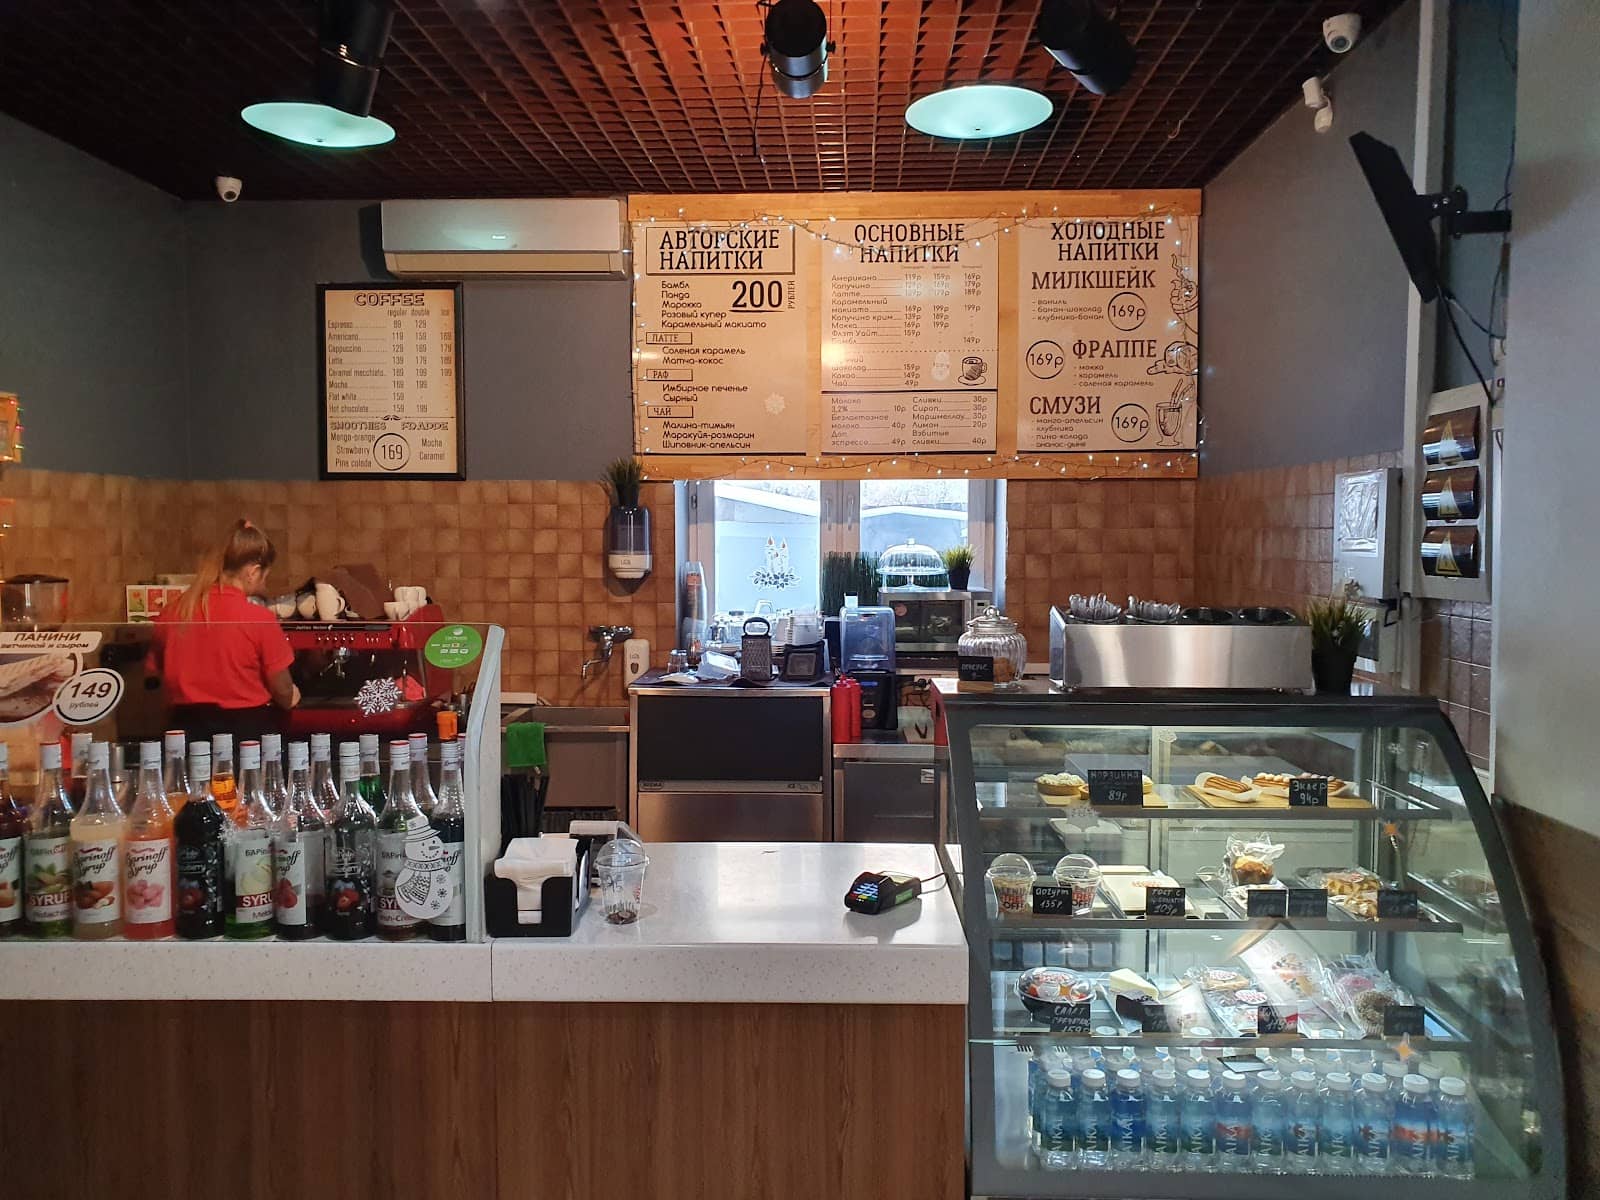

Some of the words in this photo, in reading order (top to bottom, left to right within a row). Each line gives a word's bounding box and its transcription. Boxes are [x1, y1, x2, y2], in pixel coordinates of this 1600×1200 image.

[854, 223, 964, 242] ОСНОВНЫЕ
[1051, 221, 1165, 241] ХОЛОДНЫЕ
[659, 230, 779, 249] АВТОРСКИЕ
[860, 244, 959, 263] НАПИТКИ
[1058, 242, 1159, 261] НАПИТКИ
[660, 250, 763, 270] НАПИТКИ
[832, 274, 877, 282] Американо
[1032, 266, 1156, 289] МИЛКШЕЙК
[832, 282, 871, 291] Капучино
[662, 291, 690, 300] Панда
[732, 280, 783, 308] 200
[354, 292, 424, 307] COFFEE
[832, 298, 888, 306] Карамельный
[662, 301, 702, 310] Марокко
[387, 309, 407, 318] regular
[411, 308, 430, 316] double
[662, 310, 698, 318] Розовый
[1111, 304, 1146, 320] 169р
[832, 314, 870, 322] Капучино
[1038, 314, 1104, 322] клубника-банан
[328, 320, 353, 330] Espresso
[662, 320, 722, 330] Карамельный
[328, 332, 359, 340] Americano
[652, 334, 679, 342] ЛАТТЕ
[328, 344, 362, 354] Cappuccino
[662, 346, 699, 354] Соленая
[1073, 339, 1157, 359] ФРАППЕ
[1030, 353, 1063, 368] 169р
[329, 368, 352, 376] Caramel
[653, 371, 669, 379] РАФ
[662, 384, 708, 392] Имбирное
[329, 392, 340, 400] Flat
[342, 392, 356, 400] white
[663, 394, 698, 402] Сырный
[329, 405, 339, 413] Hot
[341, 404, 368, 413] chocolate
[1030, 396, 1101, 414] СМУЗИ
[654, 406, 671, 416] ЧАЙ
[662, 421, 735, 429] Малина-тимьян
[1115, 416, 1149, 432] 169р
[330, 432, 375, 442] Mango-orange
[662, 431, 754, 440] Маракуйя-розмарин
[422, 439, 442, 447] Mocha
[662, 441, 750, 449] Шиповник-апельсин
[336, 445, 370, 455] Strawberry
[381, 444, 402, 460] 169
[420, 452, 445, 460] Caramel
[351, 459, 372, 467] colada
[14, 633, 81, 641] ПАНИНИ
[70, 682, 112, 698] 149
[242, 894, 272, 907] SYRU
